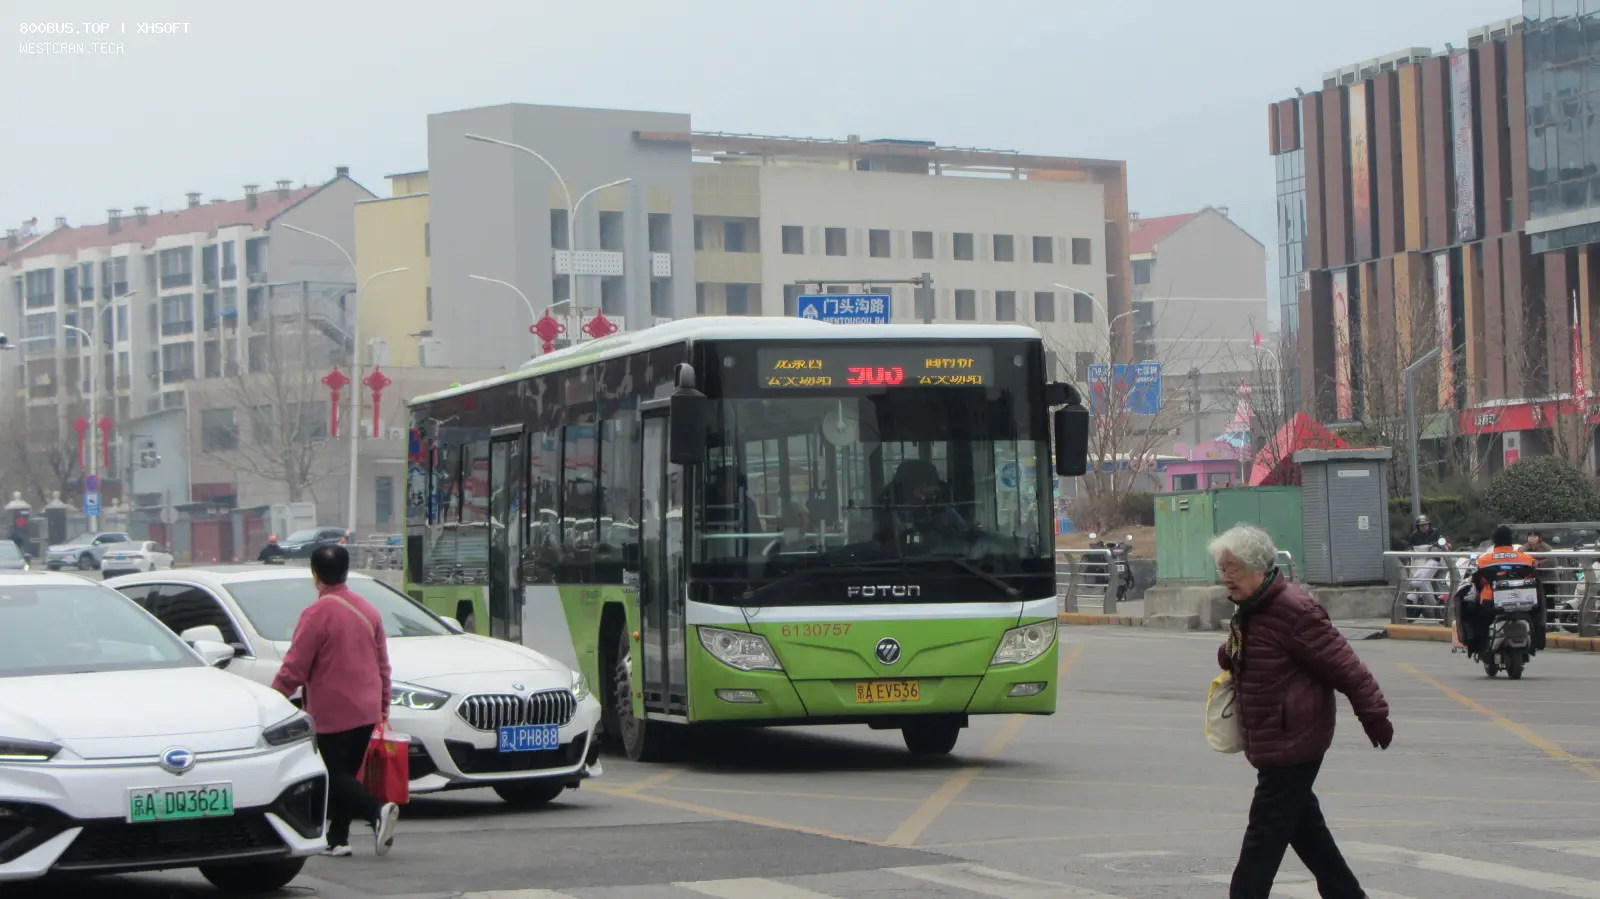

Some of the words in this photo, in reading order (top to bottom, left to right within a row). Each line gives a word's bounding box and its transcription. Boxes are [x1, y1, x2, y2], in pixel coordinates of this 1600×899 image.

[823, 298, 884, 314] 门头沟路
[848, 585, 921, 597] FOTON
[781, 623, 851, 637] 6130757
